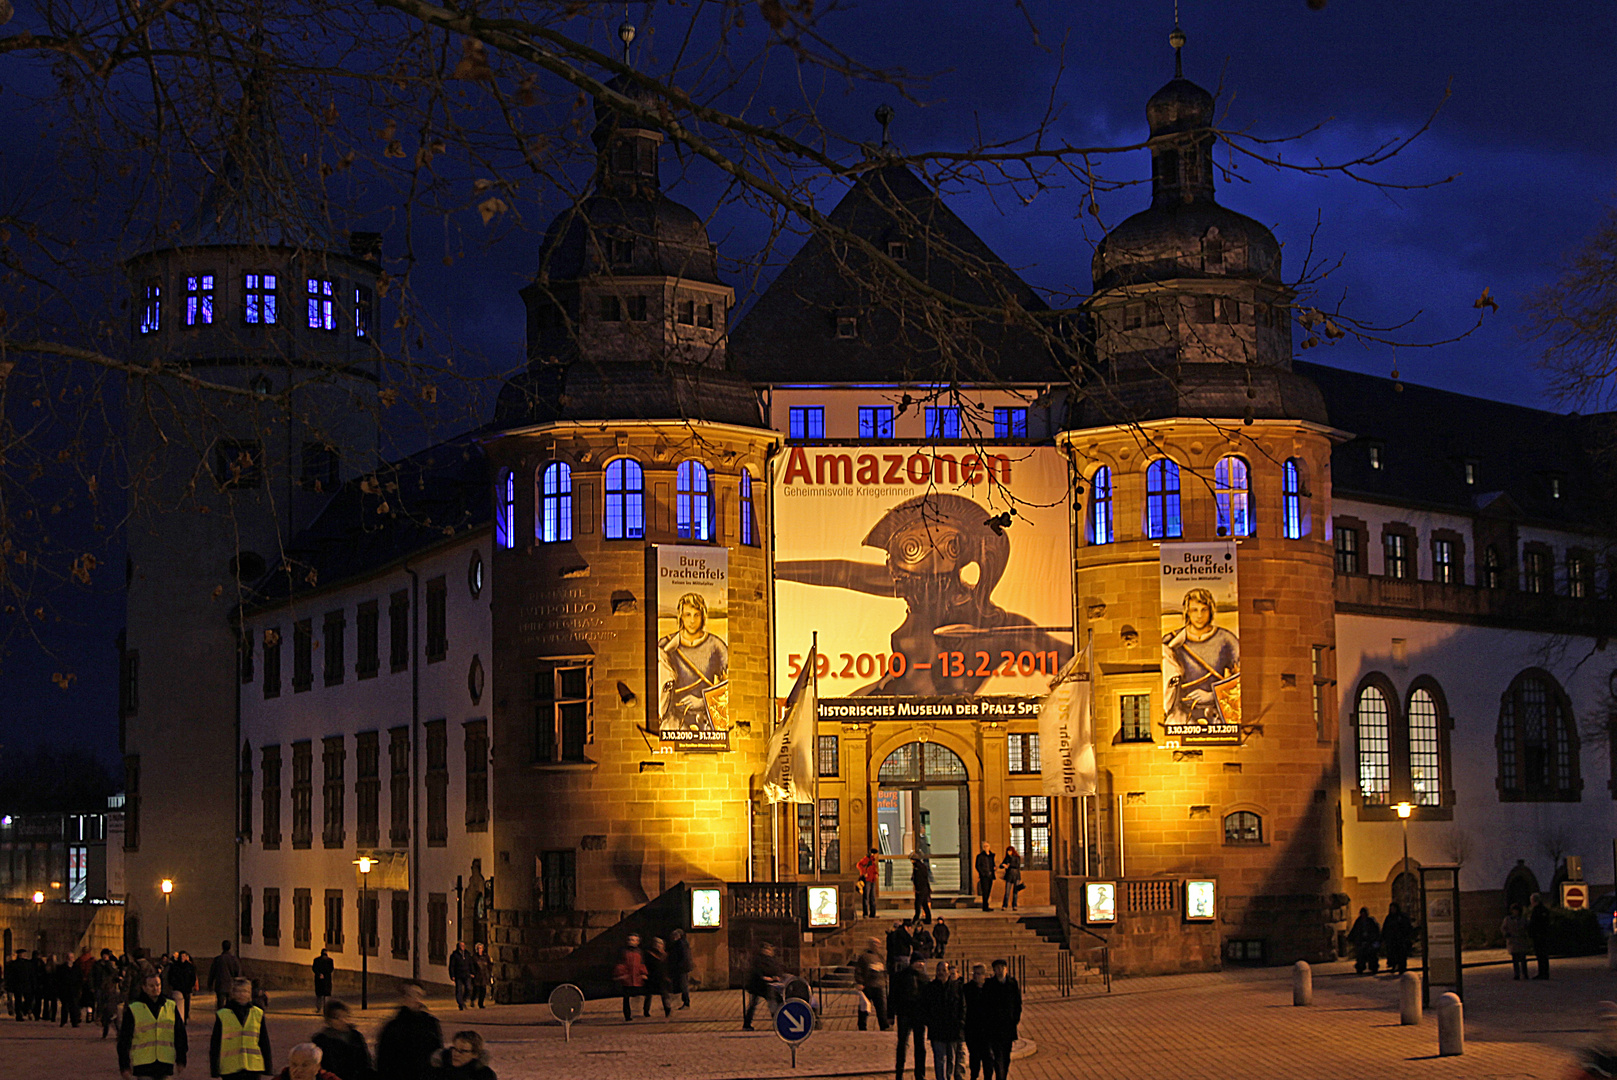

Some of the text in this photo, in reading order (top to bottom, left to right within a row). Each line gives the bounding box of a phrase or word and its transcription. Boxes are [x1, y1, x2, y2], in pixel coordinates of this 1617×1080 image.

[783, 447, 1011, 485] Amazonen
[784, 487, 914, 498] Geheimnisvolle Kriegerinnen
[680, 556, 706, 570] Burg
[1184, 553, 1212, 565] Burg
[661, 567, 725, 580] Drachenfels
[1163, 563, 1234, 575] Drachenfels
[788, 652, 907, 678] 59.2010
[938, 650, 1059, 677] 13.2.2011
[1167, 726, 1201, 734] 3.10.2010
[1208, 725, 1238, 734] 31.7.2011
[662, 732, 693, 740] 3.10.2010
[699, 732, 726, 740] 31.7.2011
[878, 790, 898, 800] Burg
[877, 799, 898, 808] nfels
